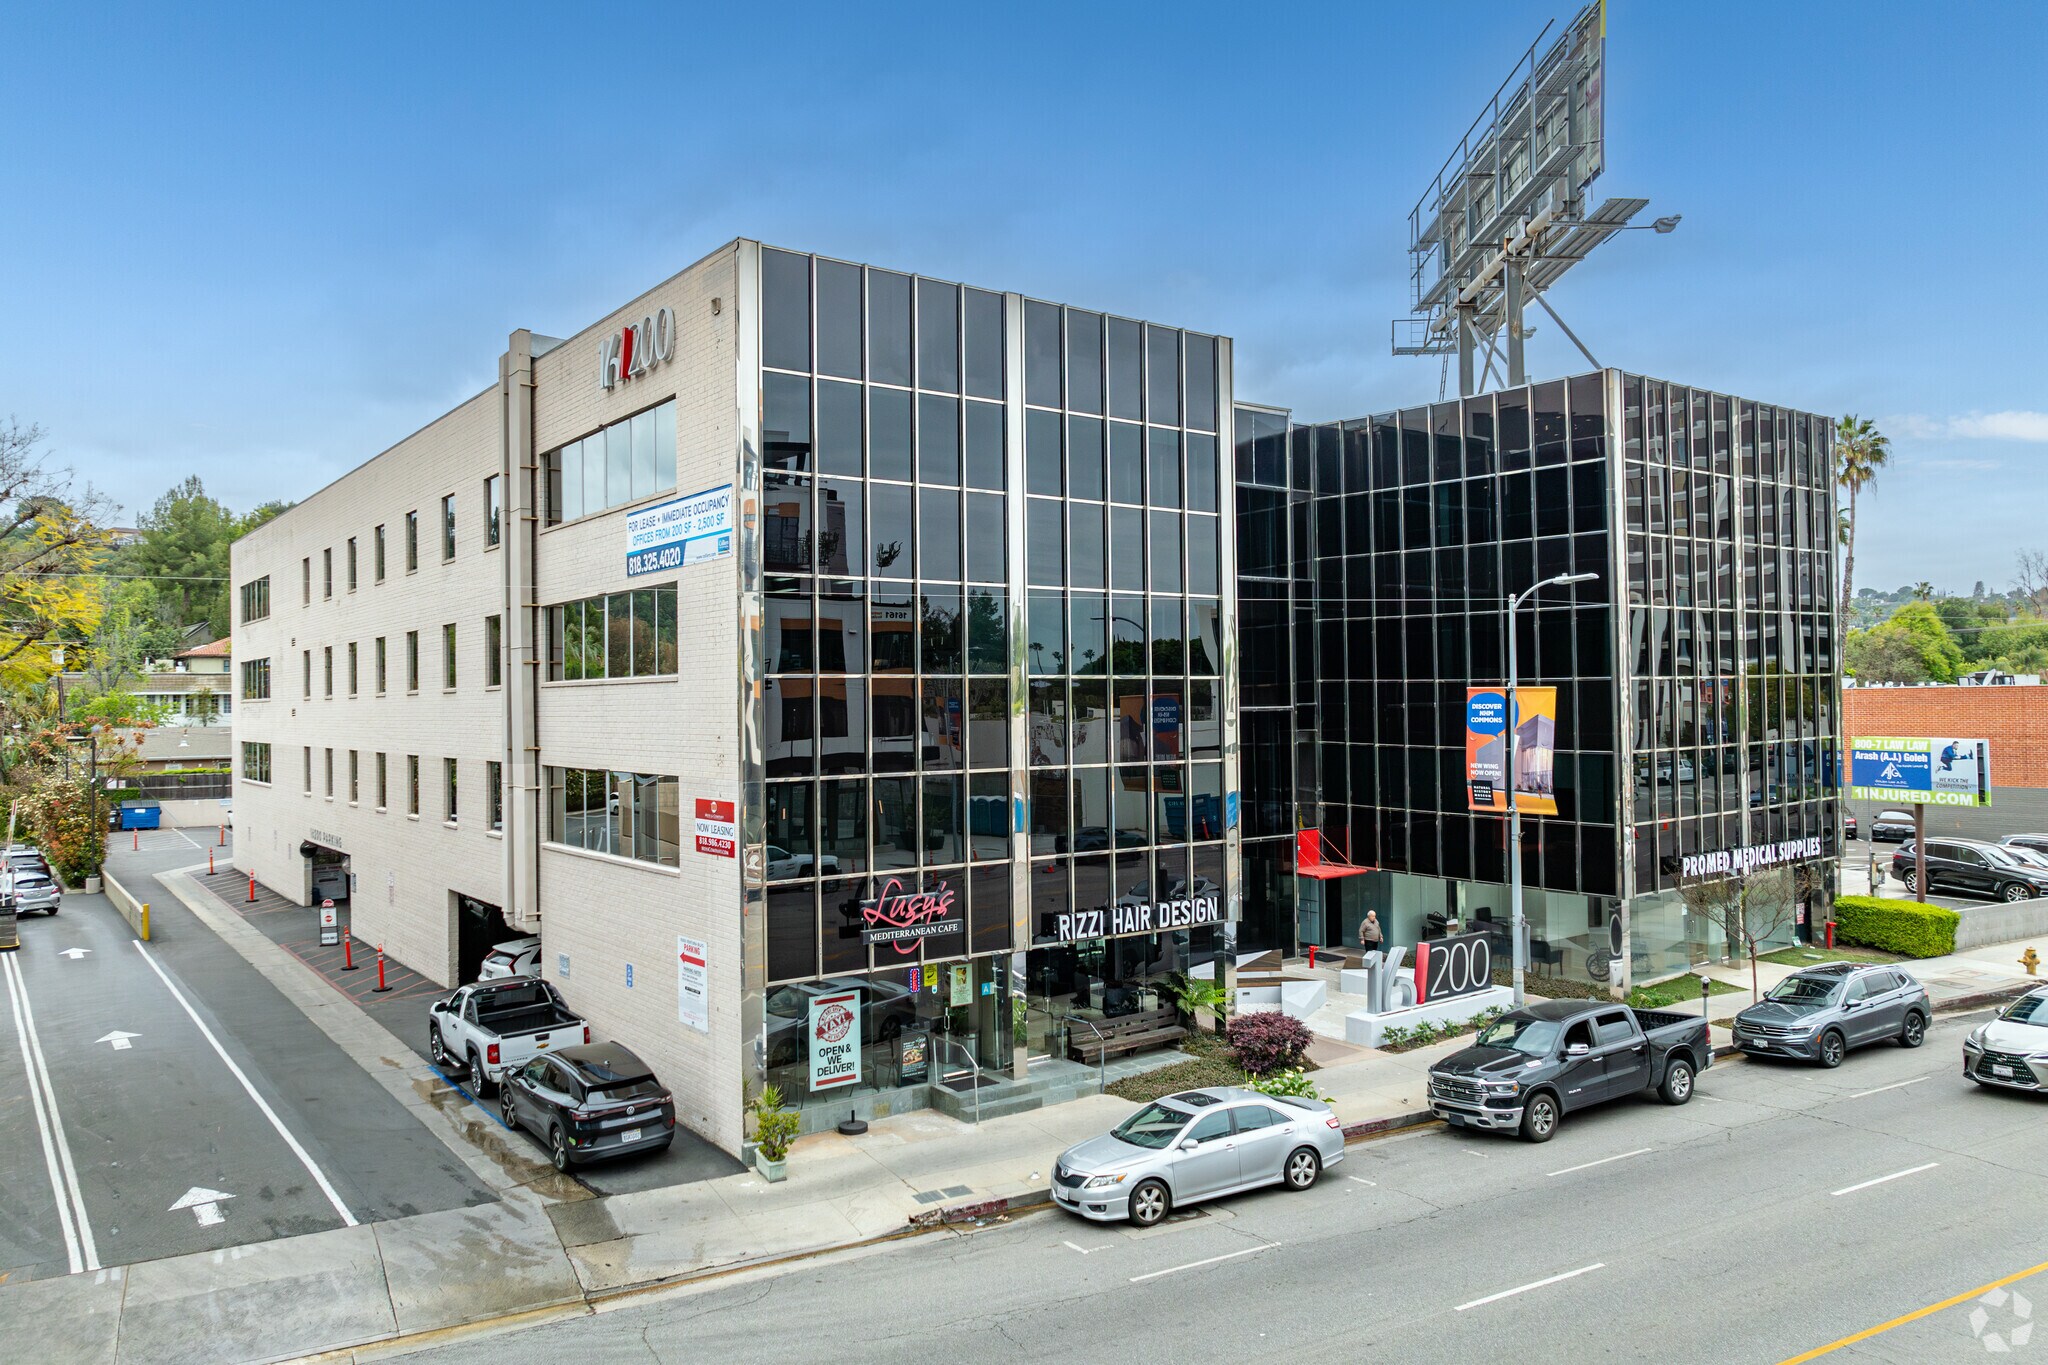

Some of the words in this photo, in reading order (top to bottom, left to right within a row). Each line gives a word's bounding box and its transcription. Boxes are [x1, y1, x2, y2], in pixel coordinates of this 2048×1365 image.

[628, 520, 638, 533] FOR
[640, 515, 656, 530] LEASE
[662, 505, 692, 523] IMMEDIATE
[694, 494, 730, 515] OCCUPANCY
[632, 531, 654, 546] OFFICES
[655, 527, 670, 540] FROM
[672, 524, 683, 536] 200
[684, 521, 691, 533] SF
[697, 515, 715, 531] 2,500
[716, 512, 725, 526] SF
[628, 546, 680, 575] 818.325.4020
[1854, 740, 1881, 750] 800-7
[1884, 740, 1904, 750] LAW
[1907, 742, 1928, 750] LAW
[1855, 751, 1878, 760] Arash
[1904, 753, 1928, 762] Goleh
[1855, 788, 1973, 806] 1INJURED.COM
[697, 823, 709, 832] NOW
[710, 824, 734, 836] LEASING
[1682, 851, 1730, 878] PROMED
[1733, 844, 1777, 869] MEDICAL
[1780, 836, 1820, 861] SUPPLIES
[1058, 910, 1104, 942] RIZZI
[1112, 904, 1150, 934] HAIR
[1158, 896, 1218, 928] DESIGN
[870, 926, 937, 942] MEDITERRANEAN
[938, 924, 958, 933] CAFE
[683, 944, 700, 955] PARKING
[819, 1045, 844, 1057] OPEN
[846, 1044, 851, 1052] &
[827, 1054, 842, 1065] WE
[817, 1062, 854, 1076] DELIVER!
